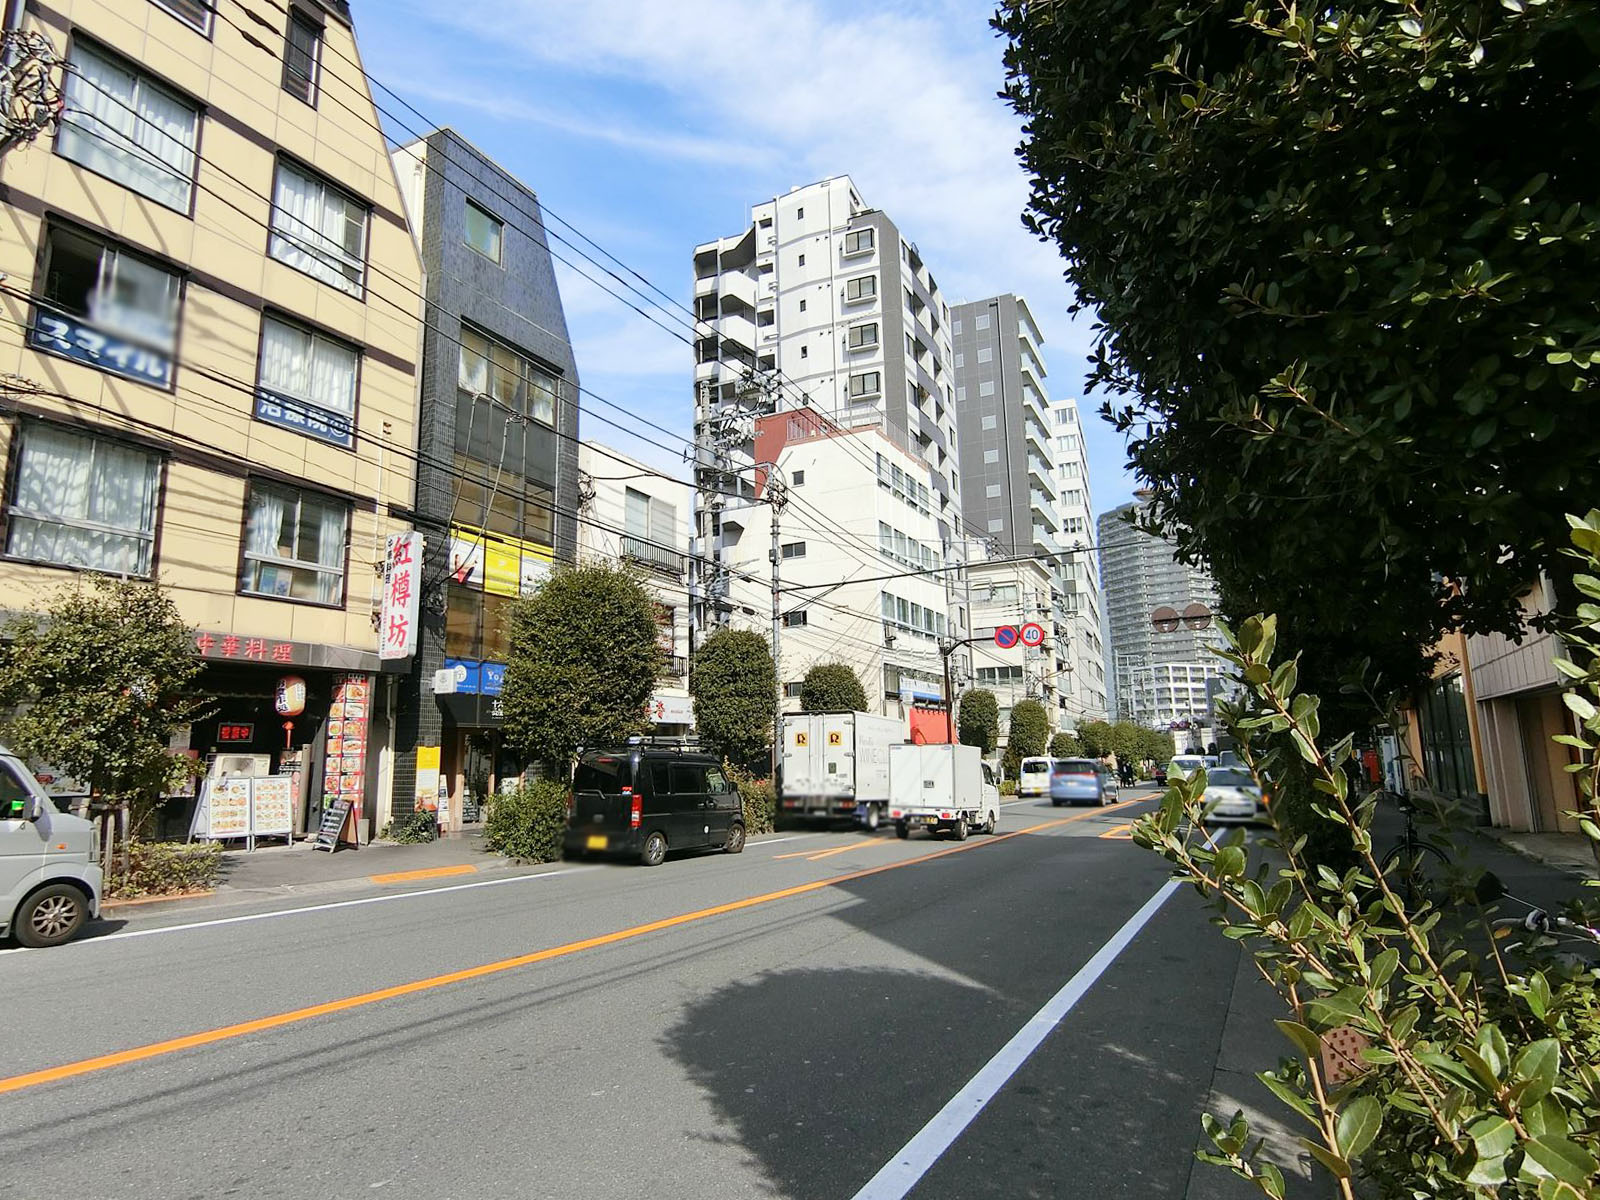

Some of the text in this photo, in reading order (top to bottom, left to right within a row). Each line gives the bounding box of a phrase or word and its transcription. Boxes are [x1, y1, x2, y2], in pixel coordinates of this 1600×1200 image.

[38, 317, 163, 378] スマイル
[387, 536, 413, 648] 紅樽坊
[196, 632, 293, 663] 中華料理
[1025, 629, 1039, 640] 40
